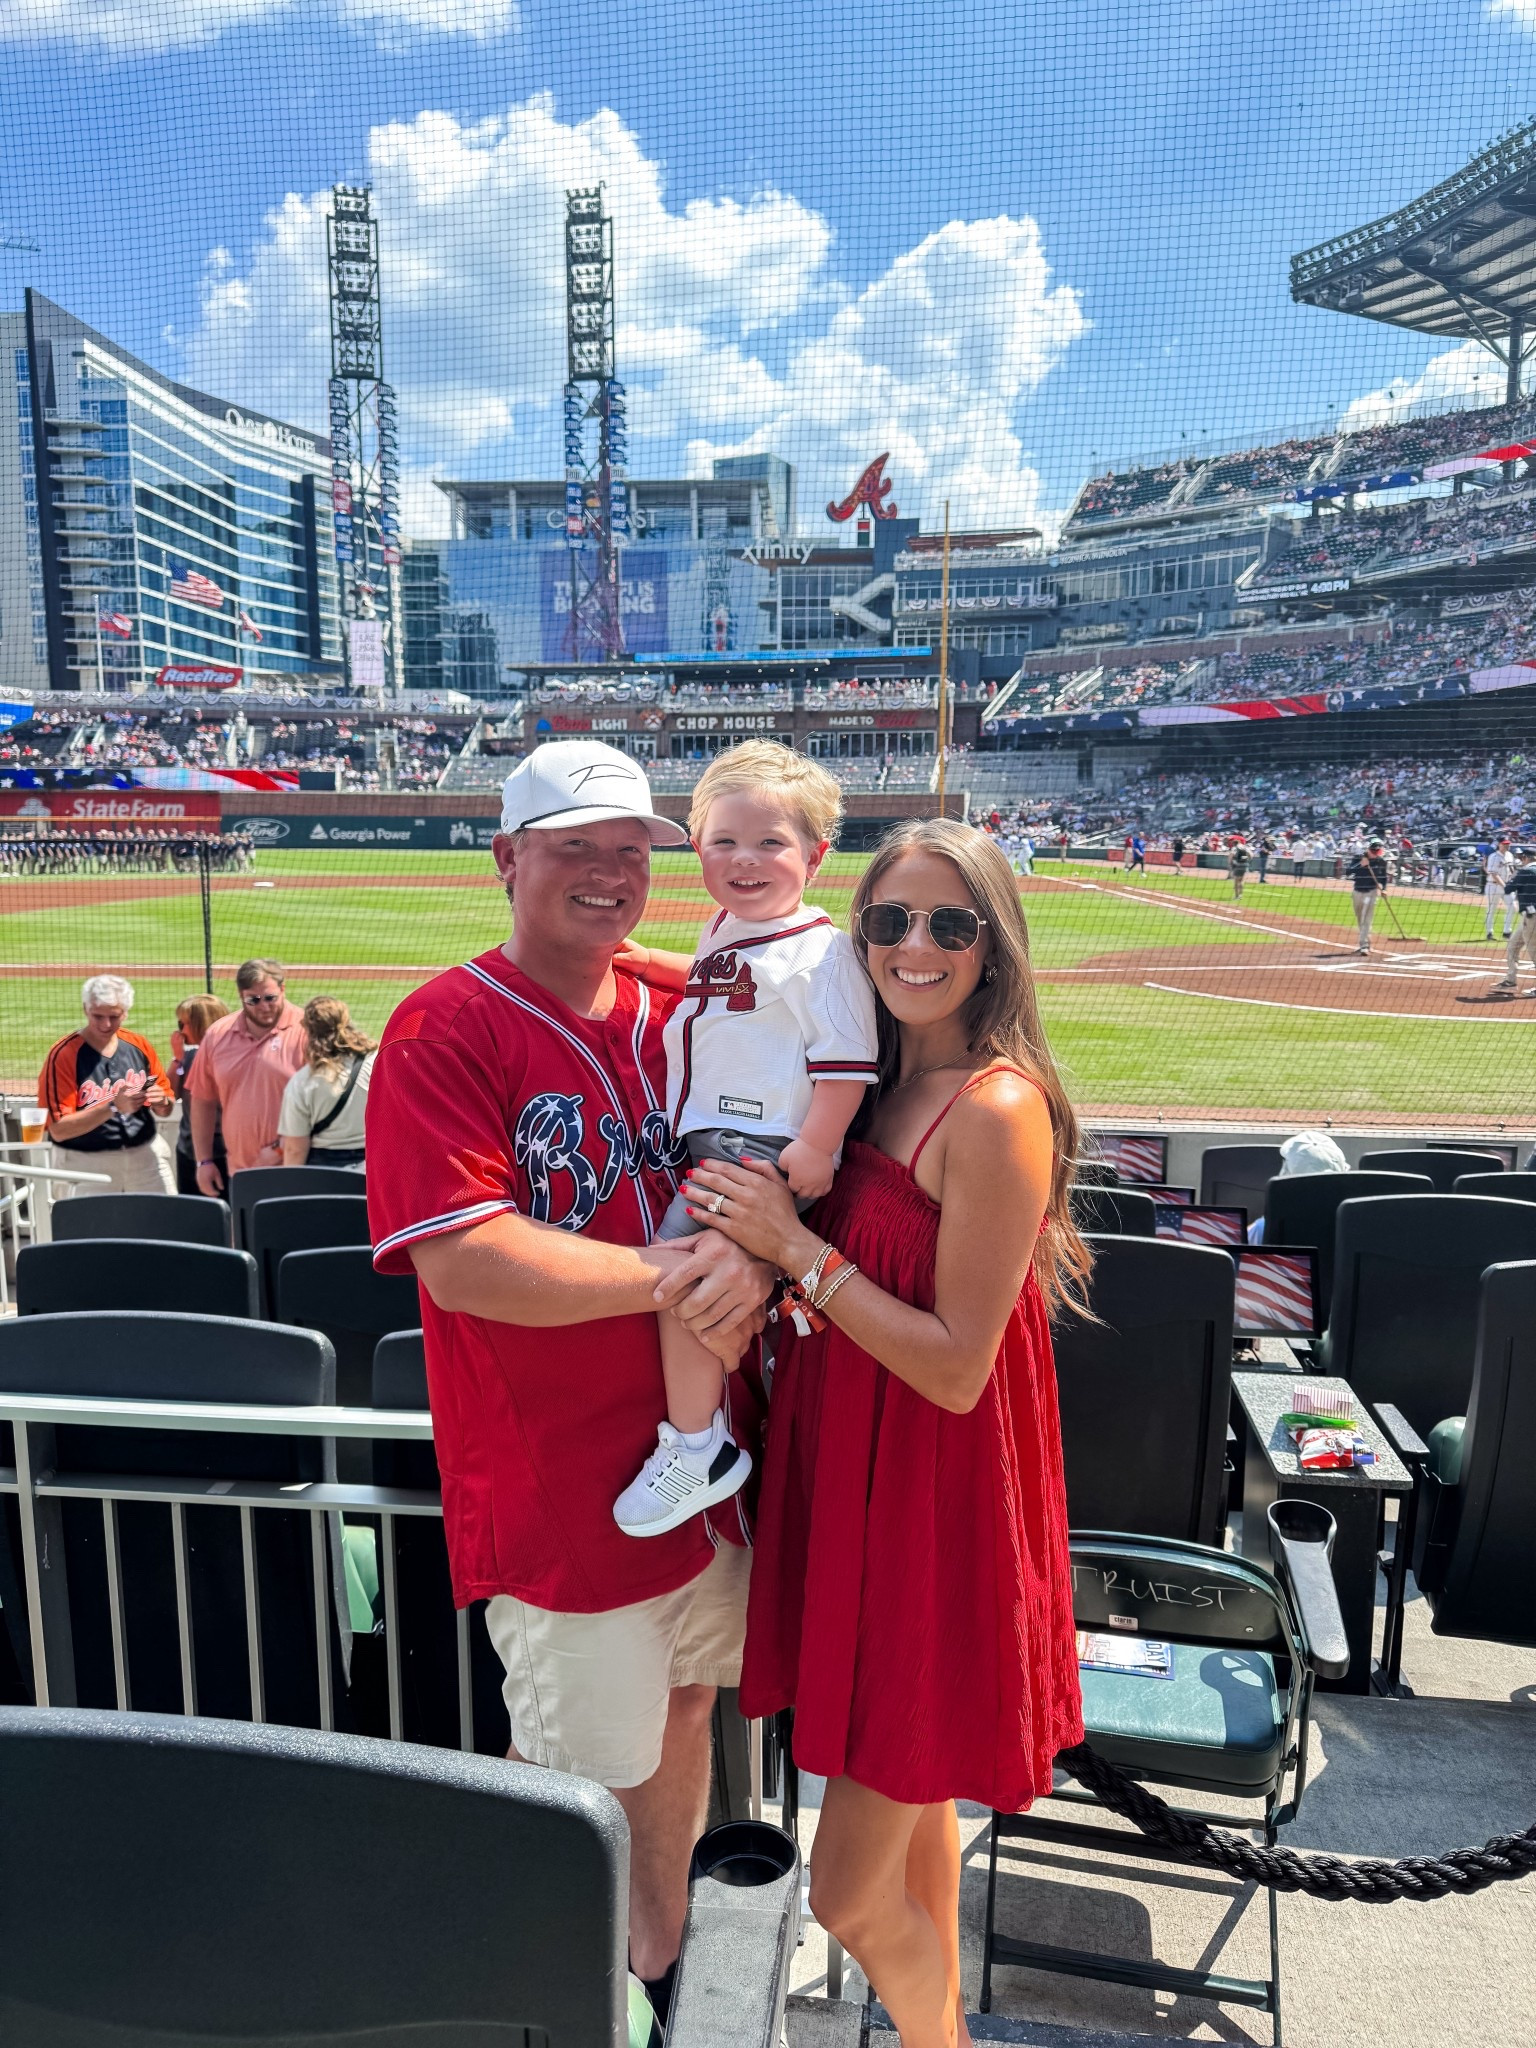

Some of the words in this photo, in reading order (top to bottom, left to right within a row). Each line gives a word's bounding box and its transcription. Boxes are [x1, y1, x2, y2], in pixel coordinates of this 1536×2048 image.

[740, 538, 815, 565] xfinity
[163, 668, 235, 684] RaceTrac
[591, 718, 628, 731] LIGHT
[676, 716, 719, 730] CHOP
[722, 715, 776, 730] HOUSE
[828, 716, 859, 726] MADE
[860, 715, 875, 726] TO
[329, 827, 376, 843] Georgia
[376, 827, 412, 841] Power
[514, 1091, 691, 1233] Bra
[1070, 1565, 1247, 1611] TRUIST
